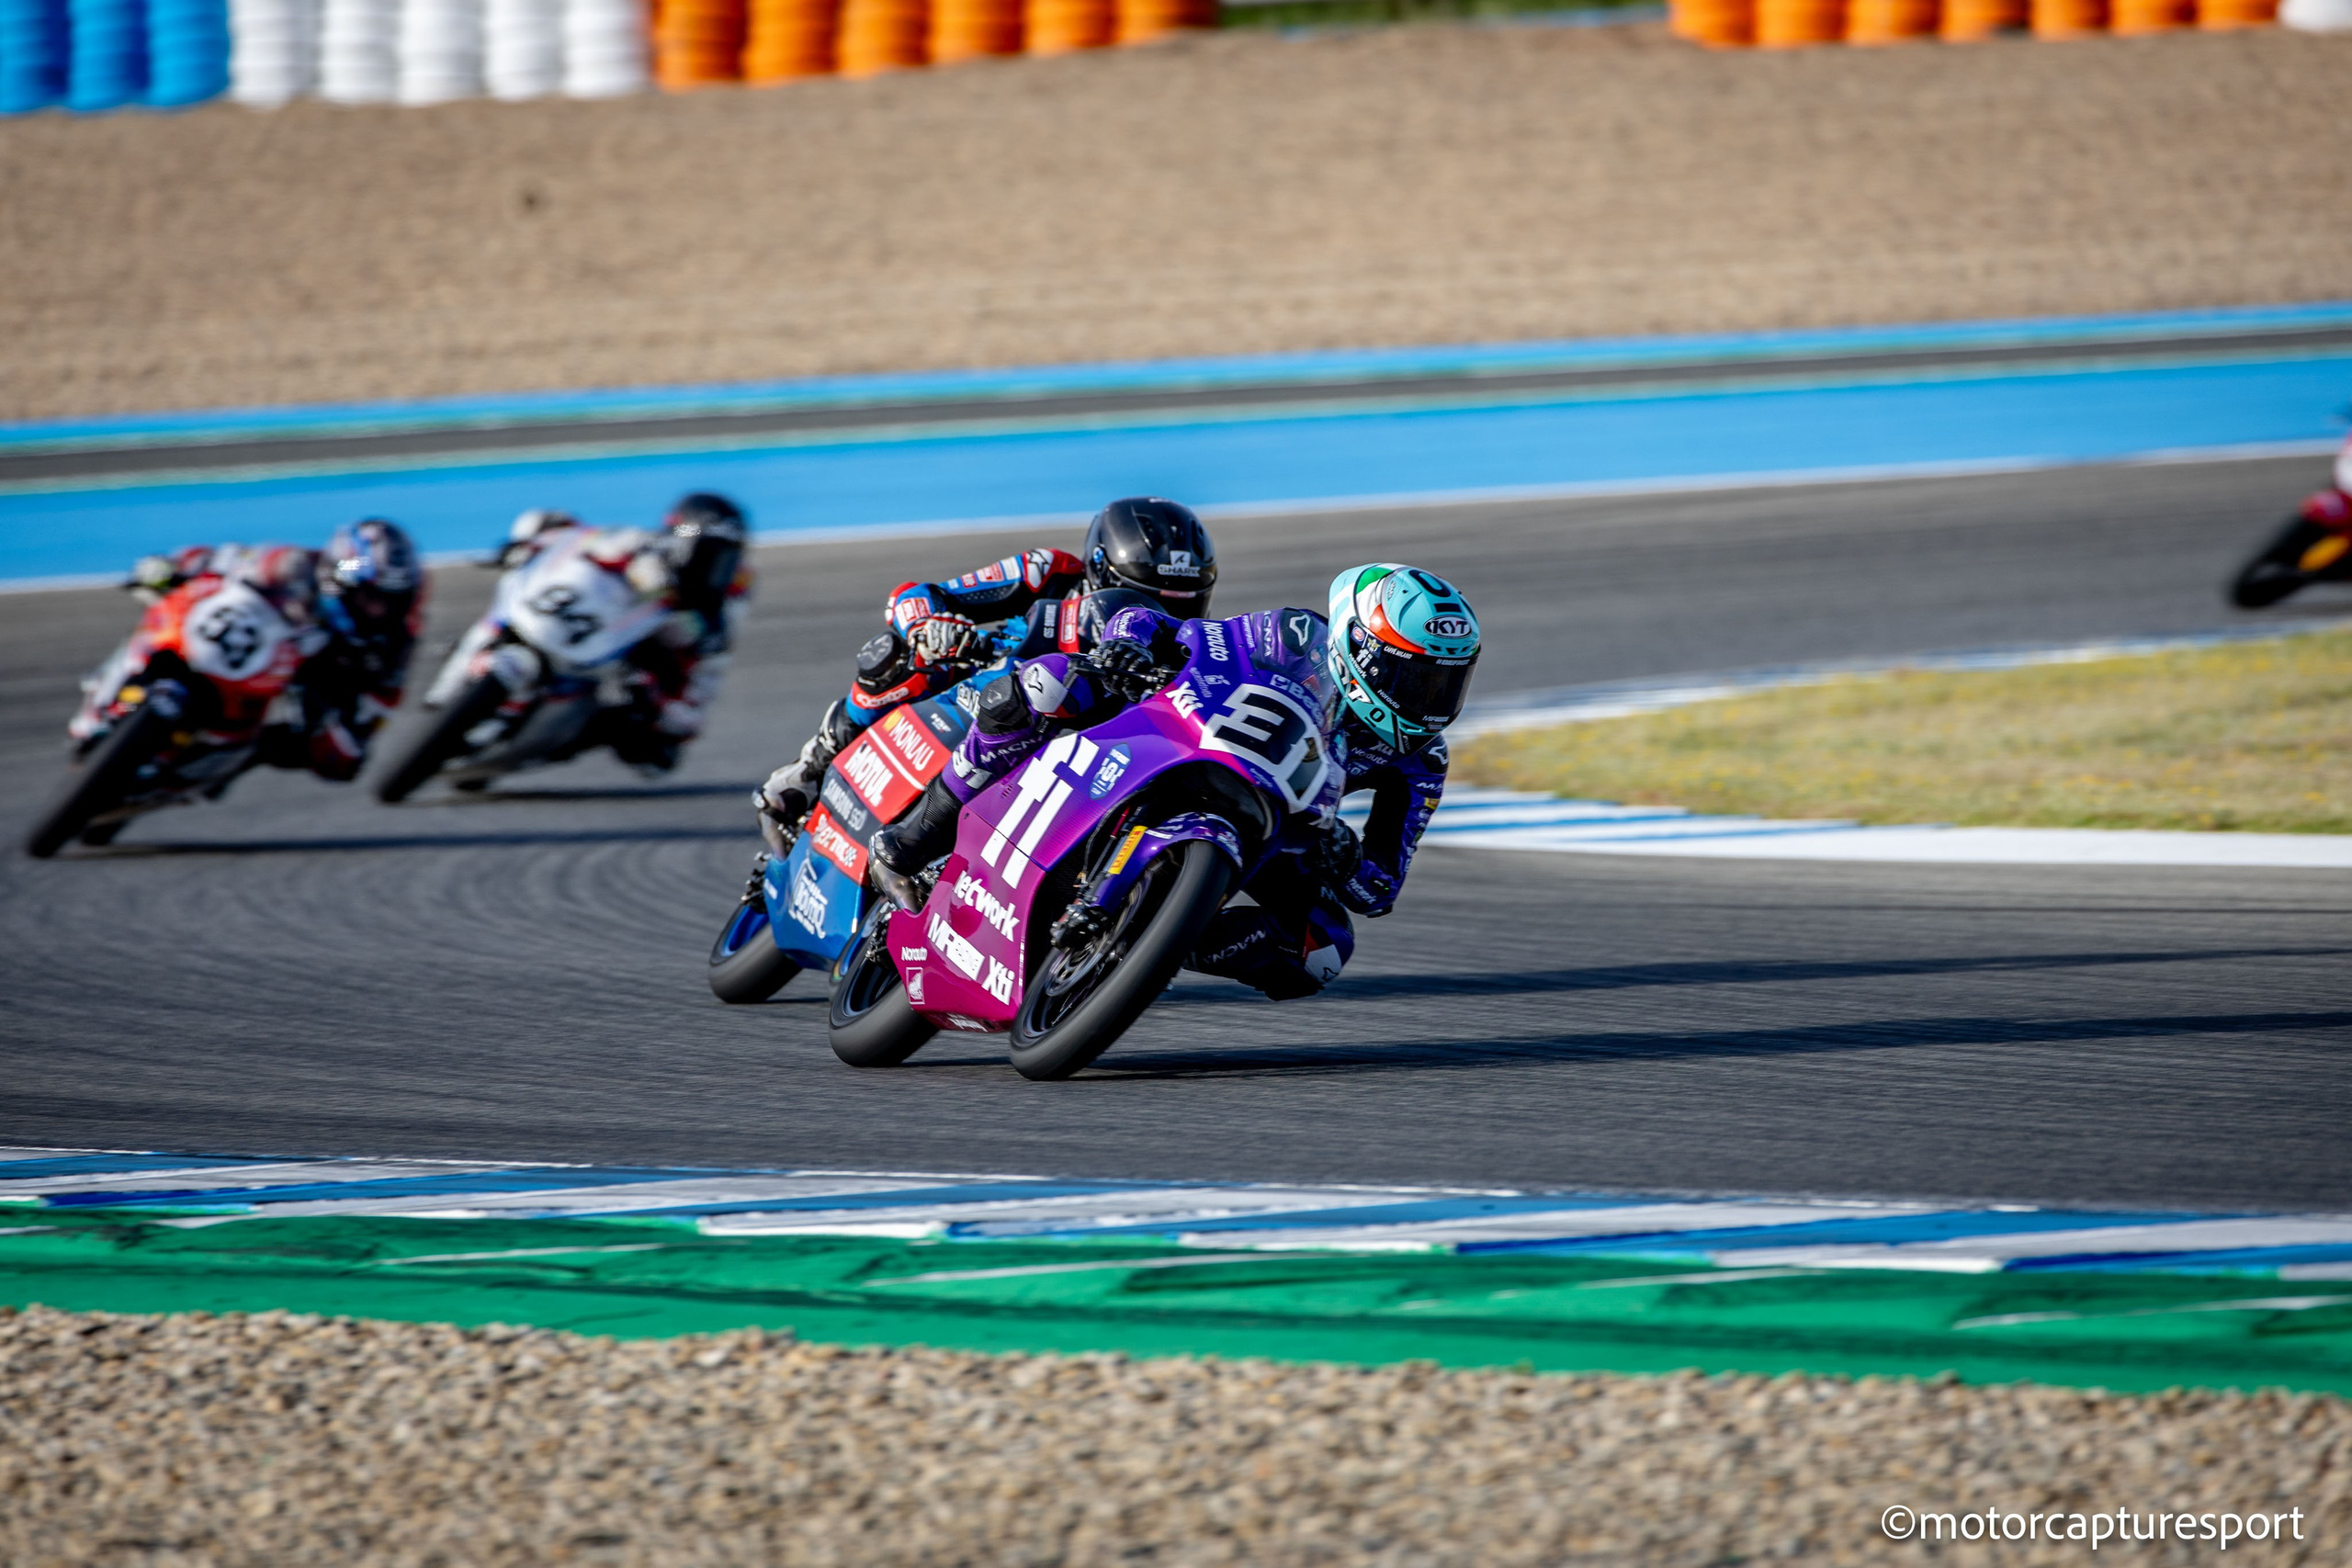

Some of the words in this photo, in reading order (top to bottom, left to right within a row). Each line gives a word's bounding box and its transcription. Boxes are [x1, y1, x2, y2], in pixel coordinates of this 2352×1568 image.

[1158, 564, 1200, 577] SHARK
[1202, 621, 1229, 661] Norauto
[1431, 620, 1468, 635] KYT
[1348, 653, 1368, 679] network
[1355, 649, 1374, 669] fi
[1165, 681, 1204, 720] Xti
[1377, 689, 1400, 709] Norauto
[888, 716, 935, 772] MONLAU
[843, 740, 894, 807] MOTUL
[980, 732, 1100, 889] fi
[901, 946, 928, 962] Norauto
[981, 954, 1016, 1007] Xti
